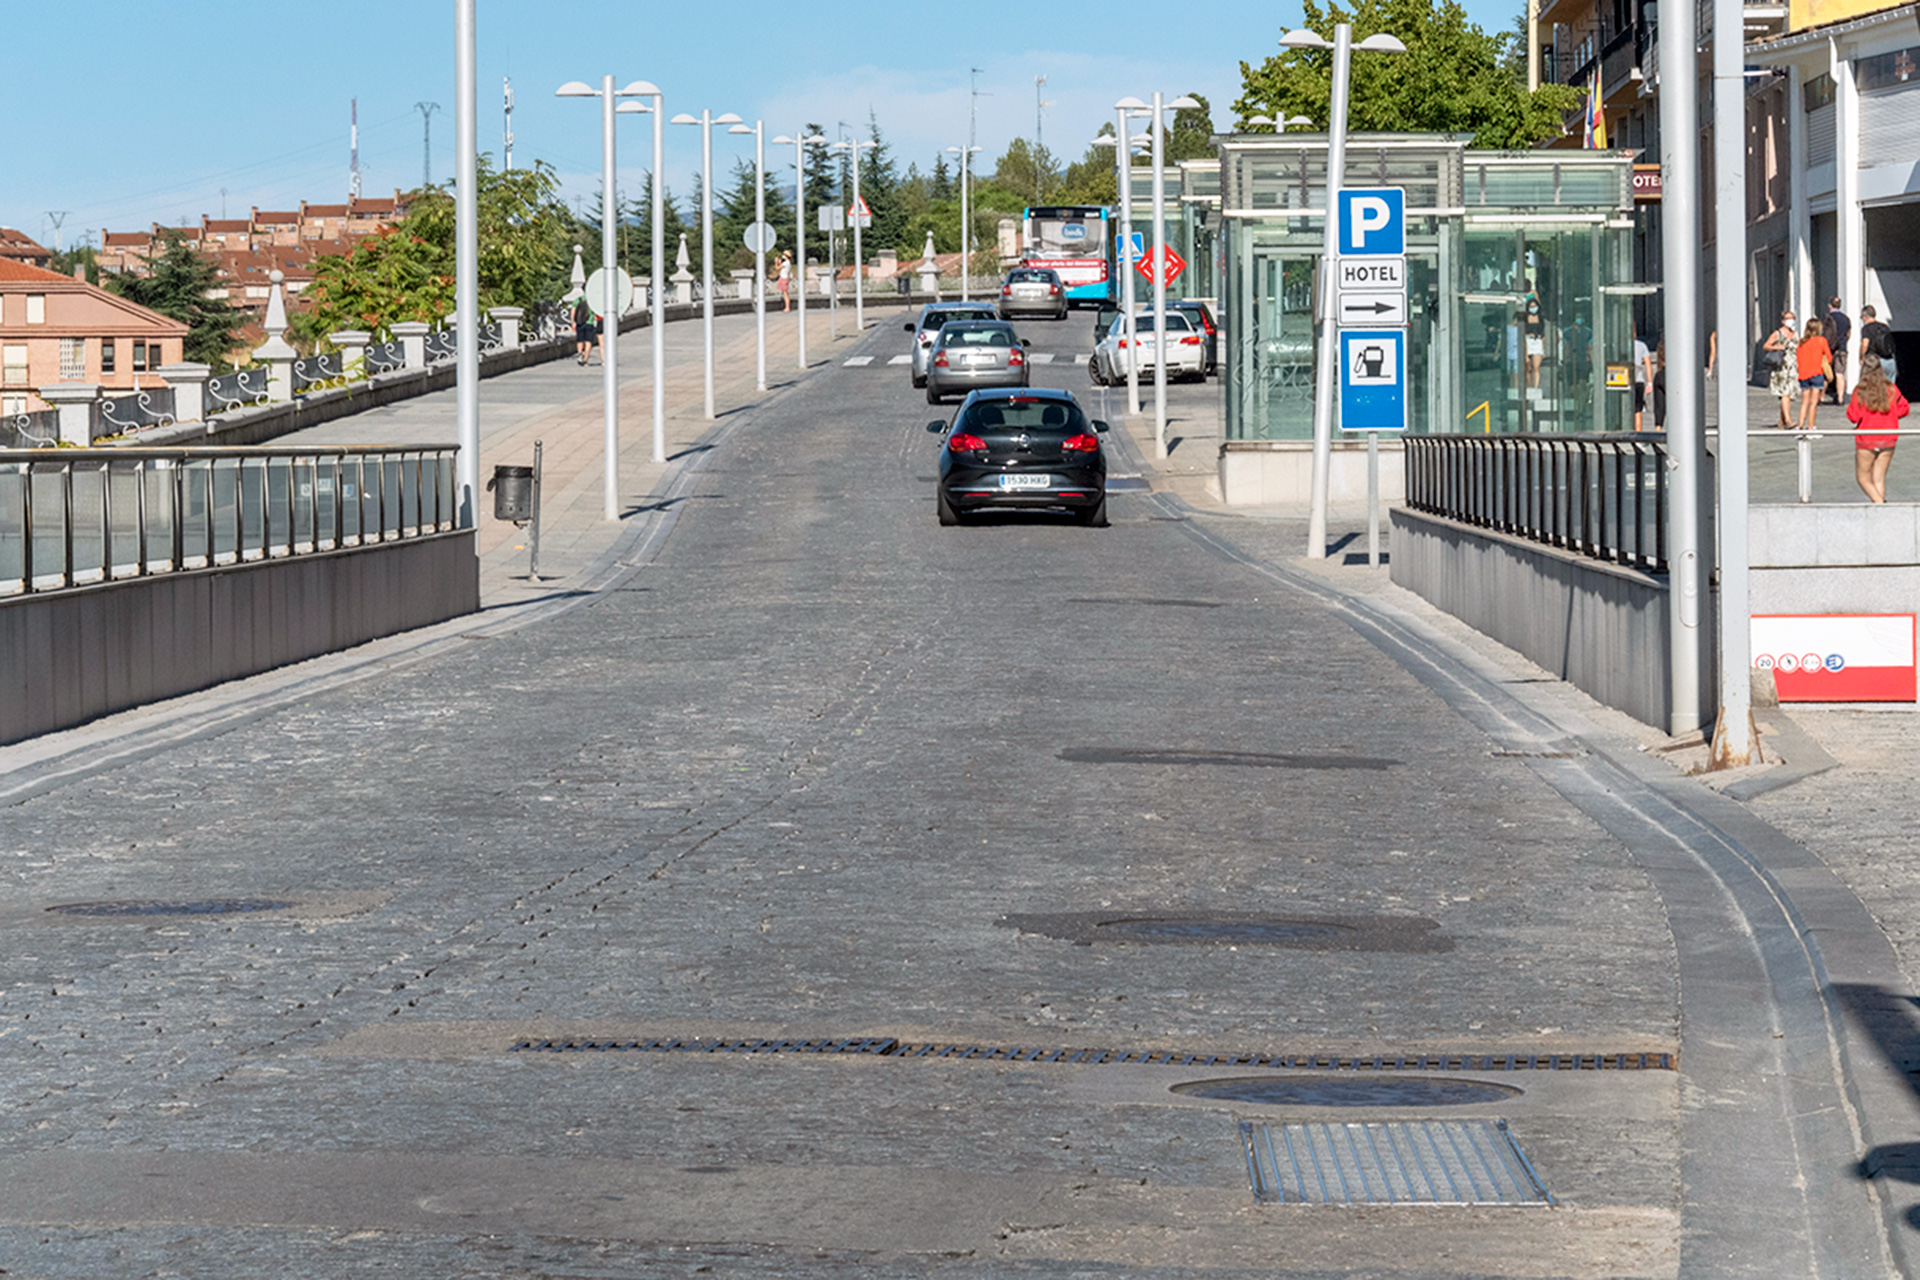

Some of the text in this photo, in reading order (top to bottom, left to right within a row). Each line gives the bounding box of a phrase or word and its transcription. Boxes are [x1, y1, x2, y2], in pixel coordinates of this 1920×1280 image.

[1633, 175, 1662, 188] OTE
[1350, 196, 1391, 248] P
[1345, 266, 1398, 281] HOTEL
